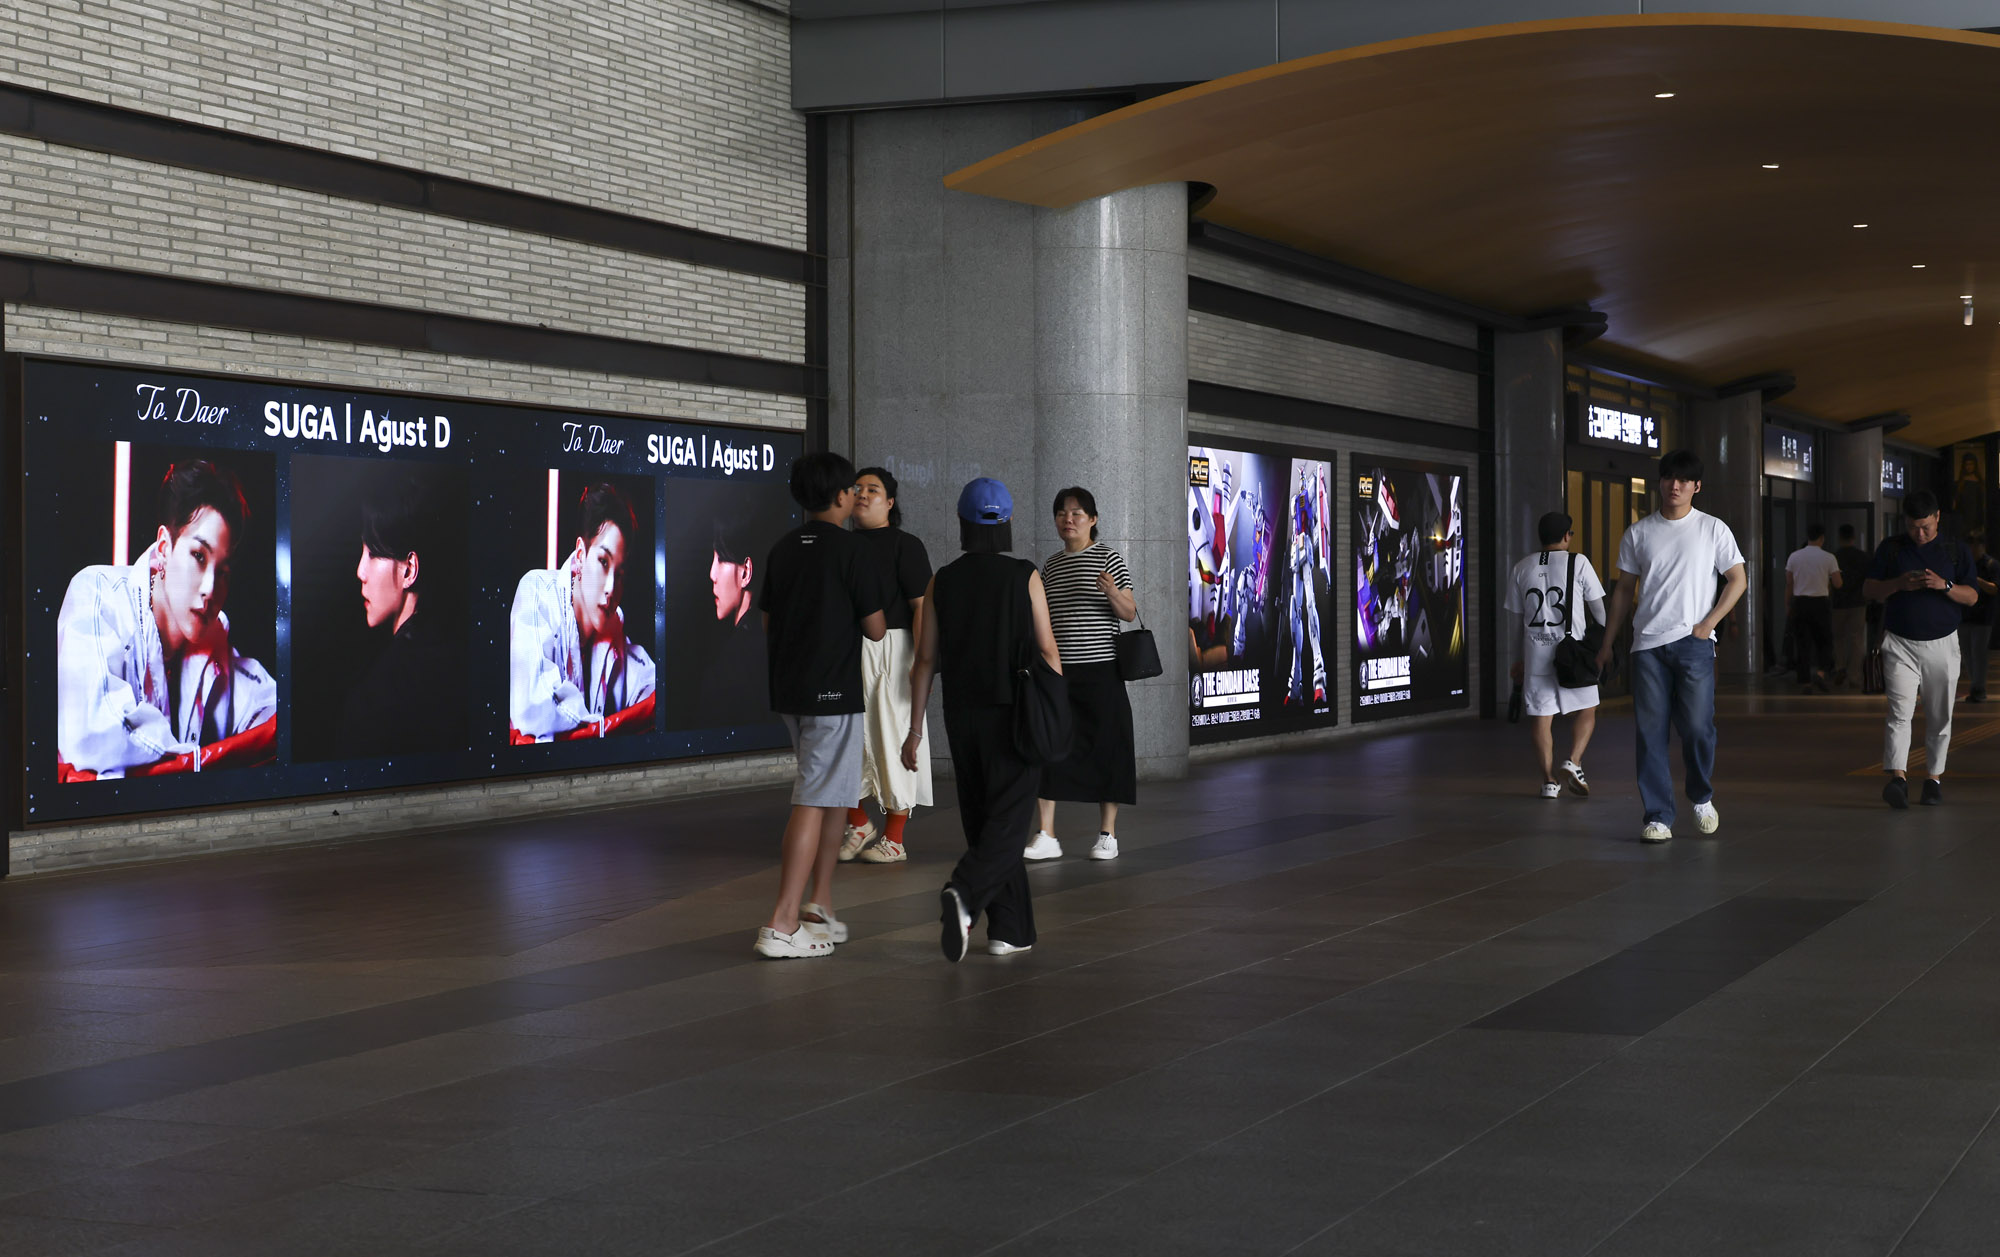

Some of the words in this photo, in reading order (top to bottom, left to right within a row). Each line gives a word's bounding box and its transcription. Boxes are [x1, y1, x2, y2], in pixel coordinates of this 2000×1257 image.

[136, 383, 168, 421] To.
[174, 388, 229, 425] Daer
[264, 400, 338, 441] SUGA
[359, 409, 427, 453] Agust
[435, 415, 451, 449] D
[562, 422, 584, 452] To.
[588, 425, 625, 455] Daer
[647, 434, 697, 466] SUGA
[711, 440, 758, 476] Agust
[763, 444, 775, 471] D
[1190, 459, 1209, 480] RG
[1359, 476, 1373, 495] RG
[1525, 586, 1566, 627] 23
[1203, 672, 1216, 696] THE
[1216, 670, 1243, 695] GUNDAM
[1243, 668, 1260, 693] BASE
[1368, 659, 1377, 680] THE
